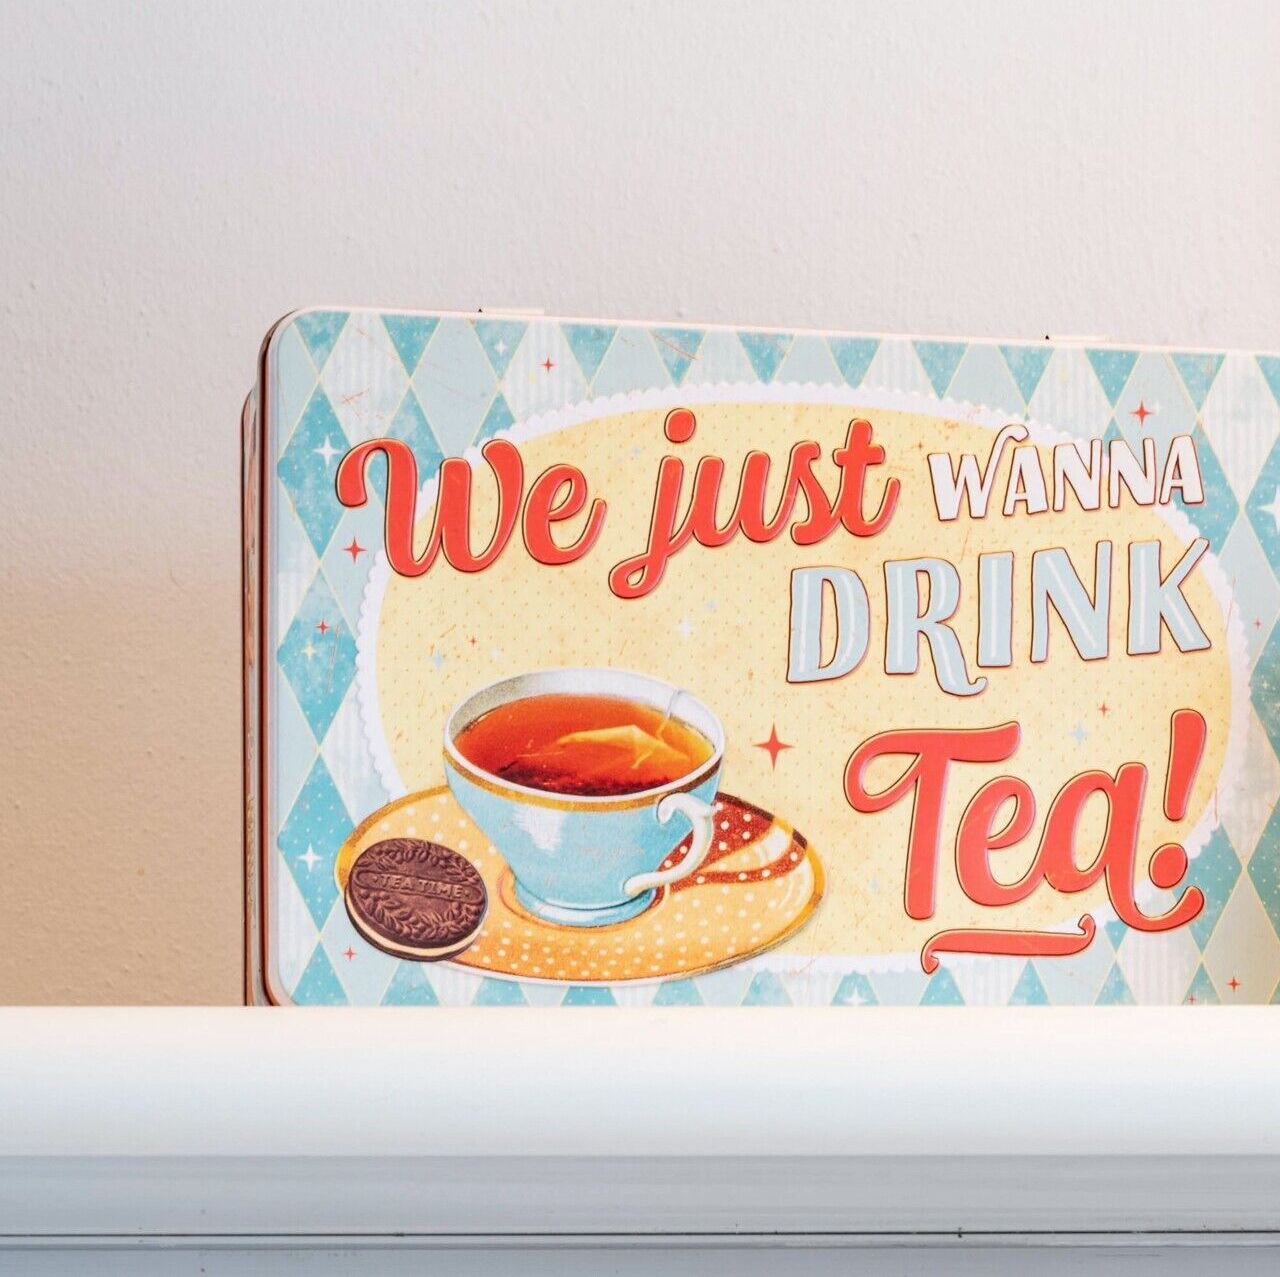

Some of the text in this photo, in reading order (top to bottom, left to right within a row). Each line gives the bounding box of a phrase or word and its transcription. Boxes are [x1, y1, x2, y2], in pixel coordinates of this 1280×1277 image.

[336, 408, 901, 599] We just
[929, 425, 1204, 521] WANNA
[786, 538, 1212, 696] DRINK
[380, 874, 464, 899] TEA TIME
[845, 709, 1206, 932] Tea!
